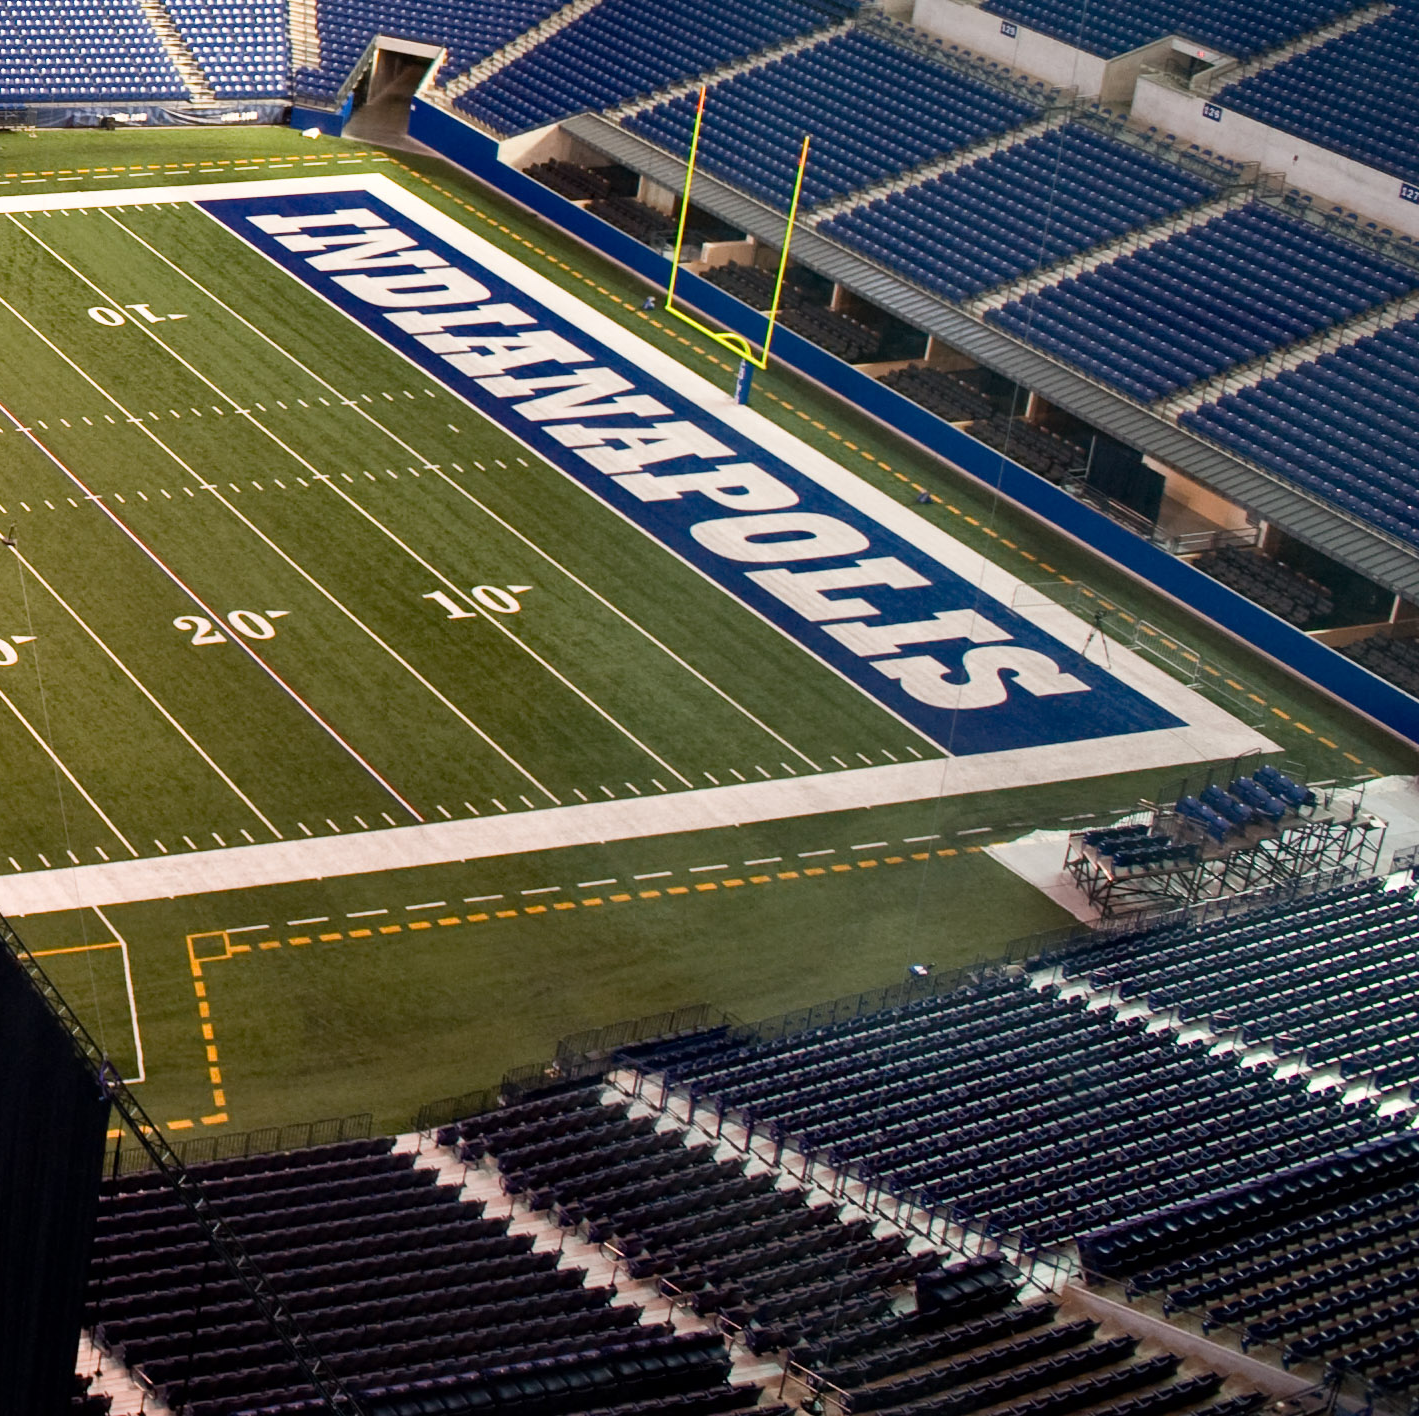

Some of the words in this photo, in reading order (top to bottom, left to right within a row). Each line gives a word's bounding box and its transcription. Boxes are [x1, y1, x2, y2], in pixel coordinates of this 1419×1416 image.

[1001, 23, 1016, 36] 125
[1204, 106, 1220, 119] 126
[1400, 185, 1419, 201] 127
[87, 303, 168, 327] 10
[247, 206, 1091, 710] INDIANAPOLIS
[422, 584, 525, 620] 10
[173, 609, 276, 646] 20
